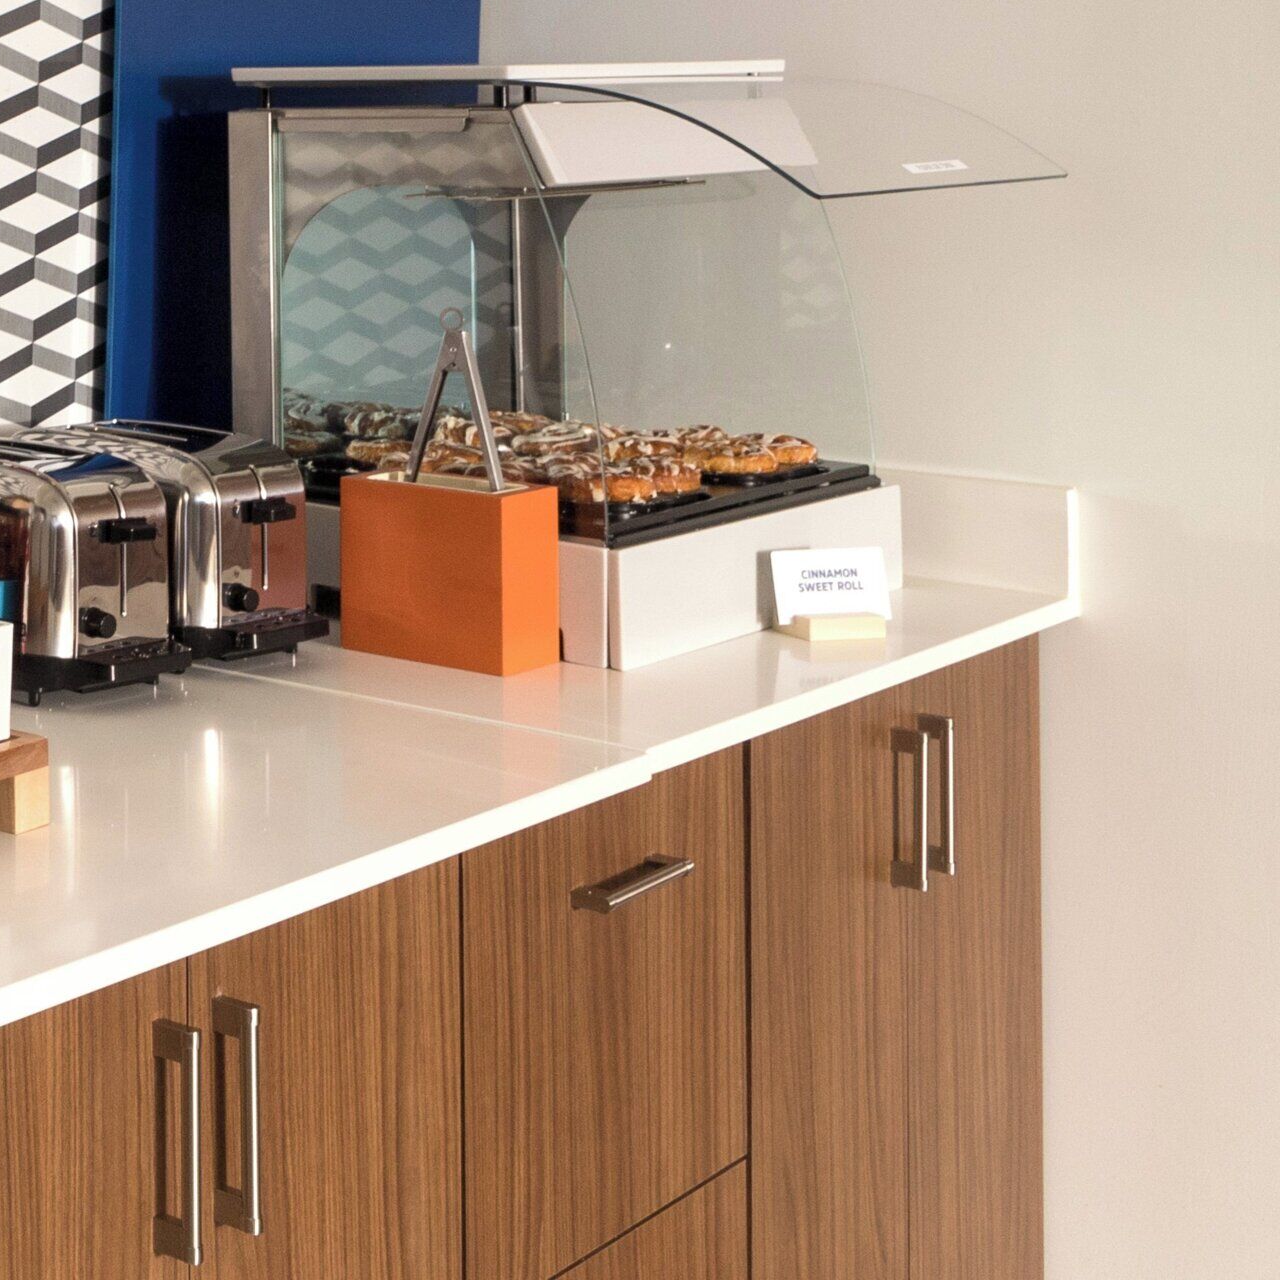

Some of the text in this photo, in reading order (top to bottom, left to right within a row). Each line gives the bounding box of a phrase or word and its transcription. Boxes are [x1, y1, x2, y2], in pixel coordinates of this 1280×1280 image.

[801, 568, 858, 580] CINNAMON
[798, 580, 864, 593] SWEET ROLL
